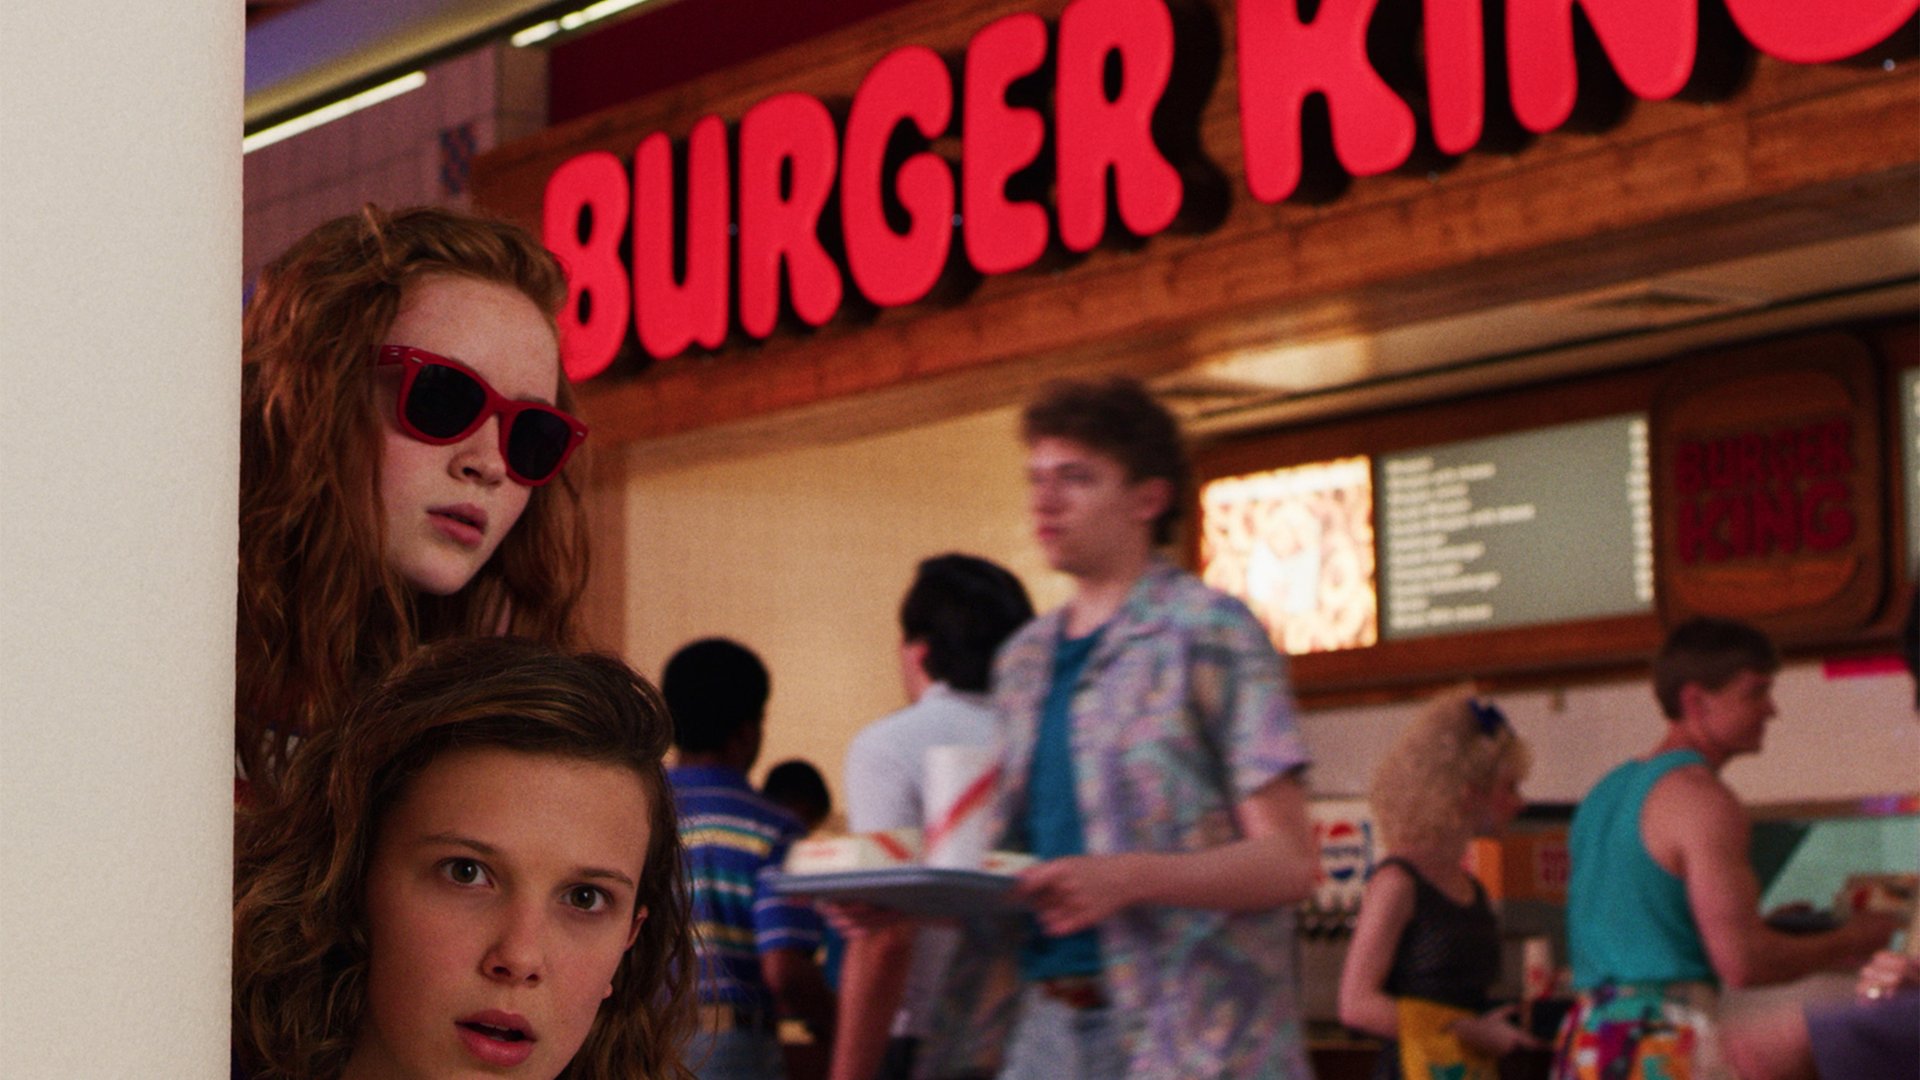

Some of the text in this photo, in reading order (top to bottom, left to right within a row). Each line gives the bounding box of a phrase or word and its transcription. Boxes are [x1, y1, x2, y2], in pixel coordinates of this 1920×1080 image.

[543, 0, 1918, 383] BURGER KI
[1675, 418, 1853, 496] BURGER
[1678, 480, 1857, 566] KING
